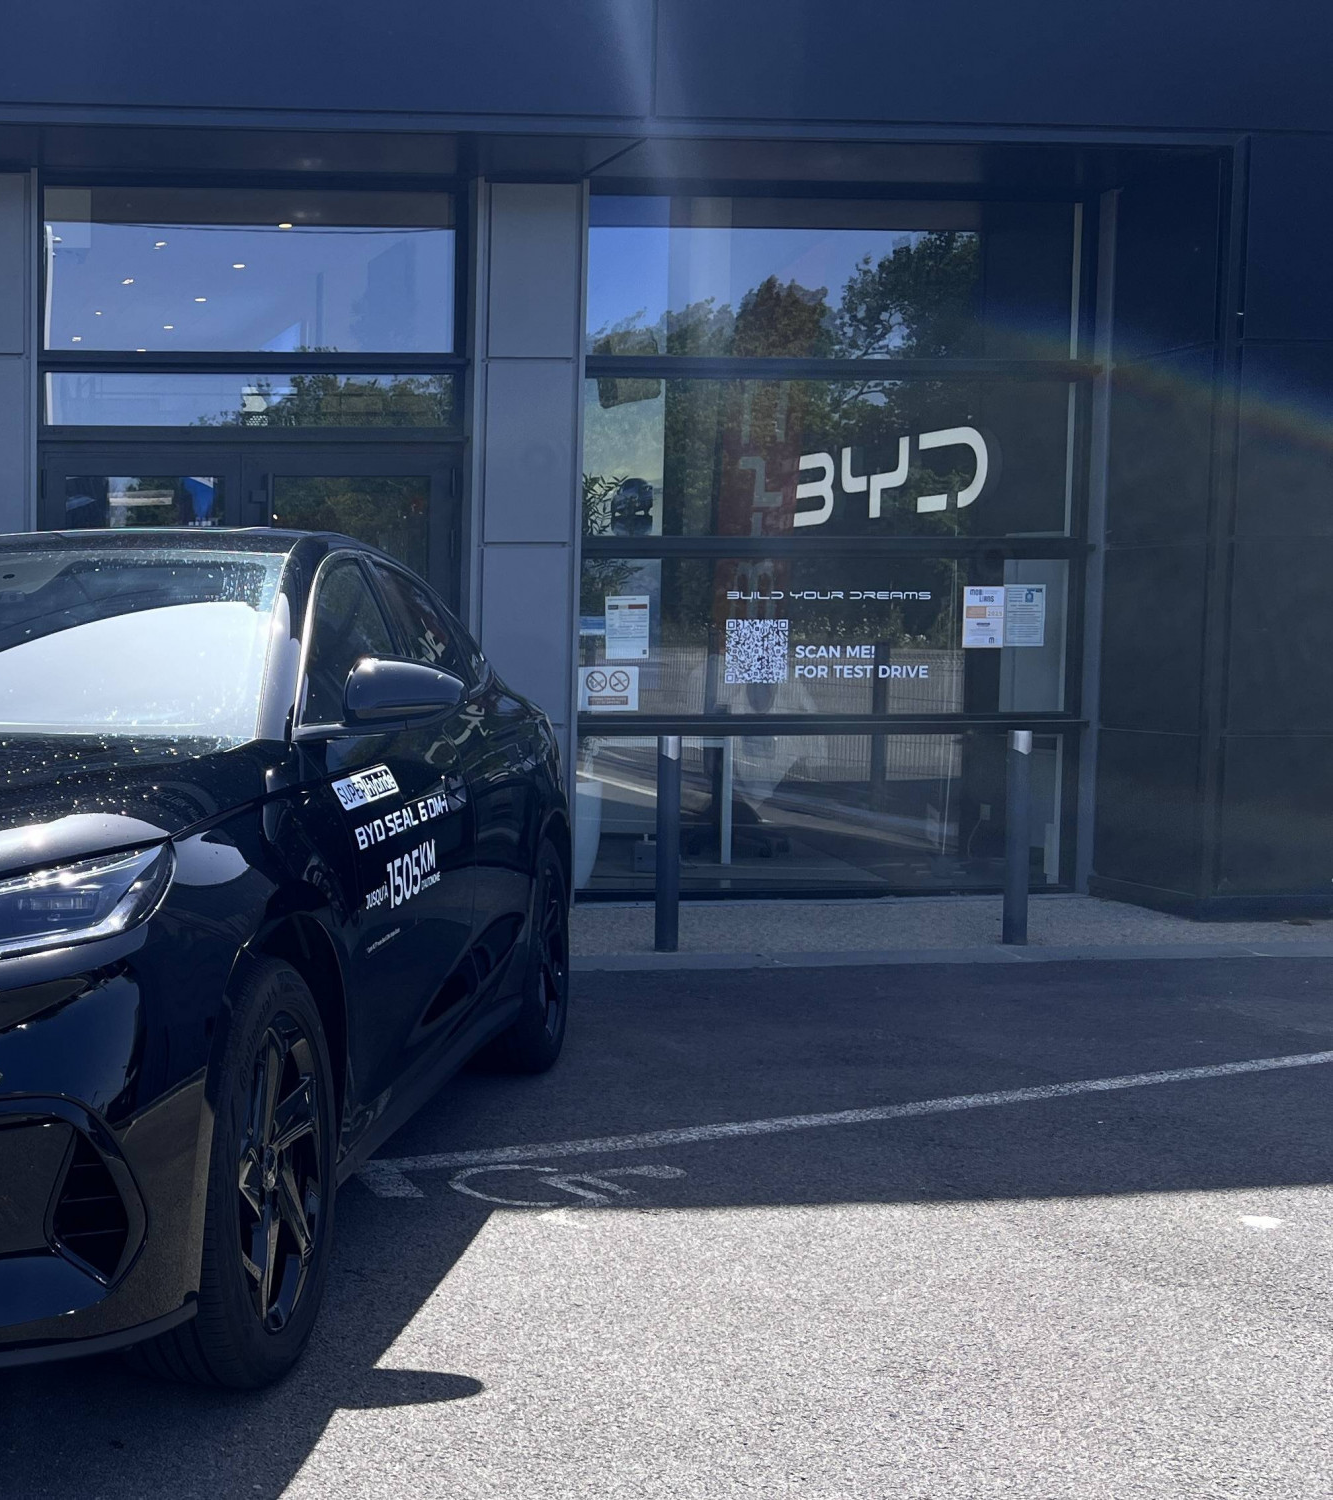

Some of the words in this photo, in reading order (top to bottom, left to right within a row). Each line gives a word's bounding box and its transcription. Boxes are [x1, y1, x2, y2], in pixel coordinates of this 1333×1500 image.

[793, 427, 988, 527] BYD
[727, 591, 784, 600] BUILD
[790, 591, 844, 600] YOUR
[849, 591, 931, 600] DREAMS
[794, 645, 841, 659] SCAN
[846, 645, 876, 658] ME!
[794, 665, 828, 679] FOR
[833, 665, 874, 679] TEST
[878, 665, 929, 679] DRIVE
[337, 780, 367, 805] SUPER
[354, 819, 386, 851] BYD
[384, 806, 419, 837] SEAL
[417, 801, 429, 822] 6
[427, 793, 449, 818] DM-i
